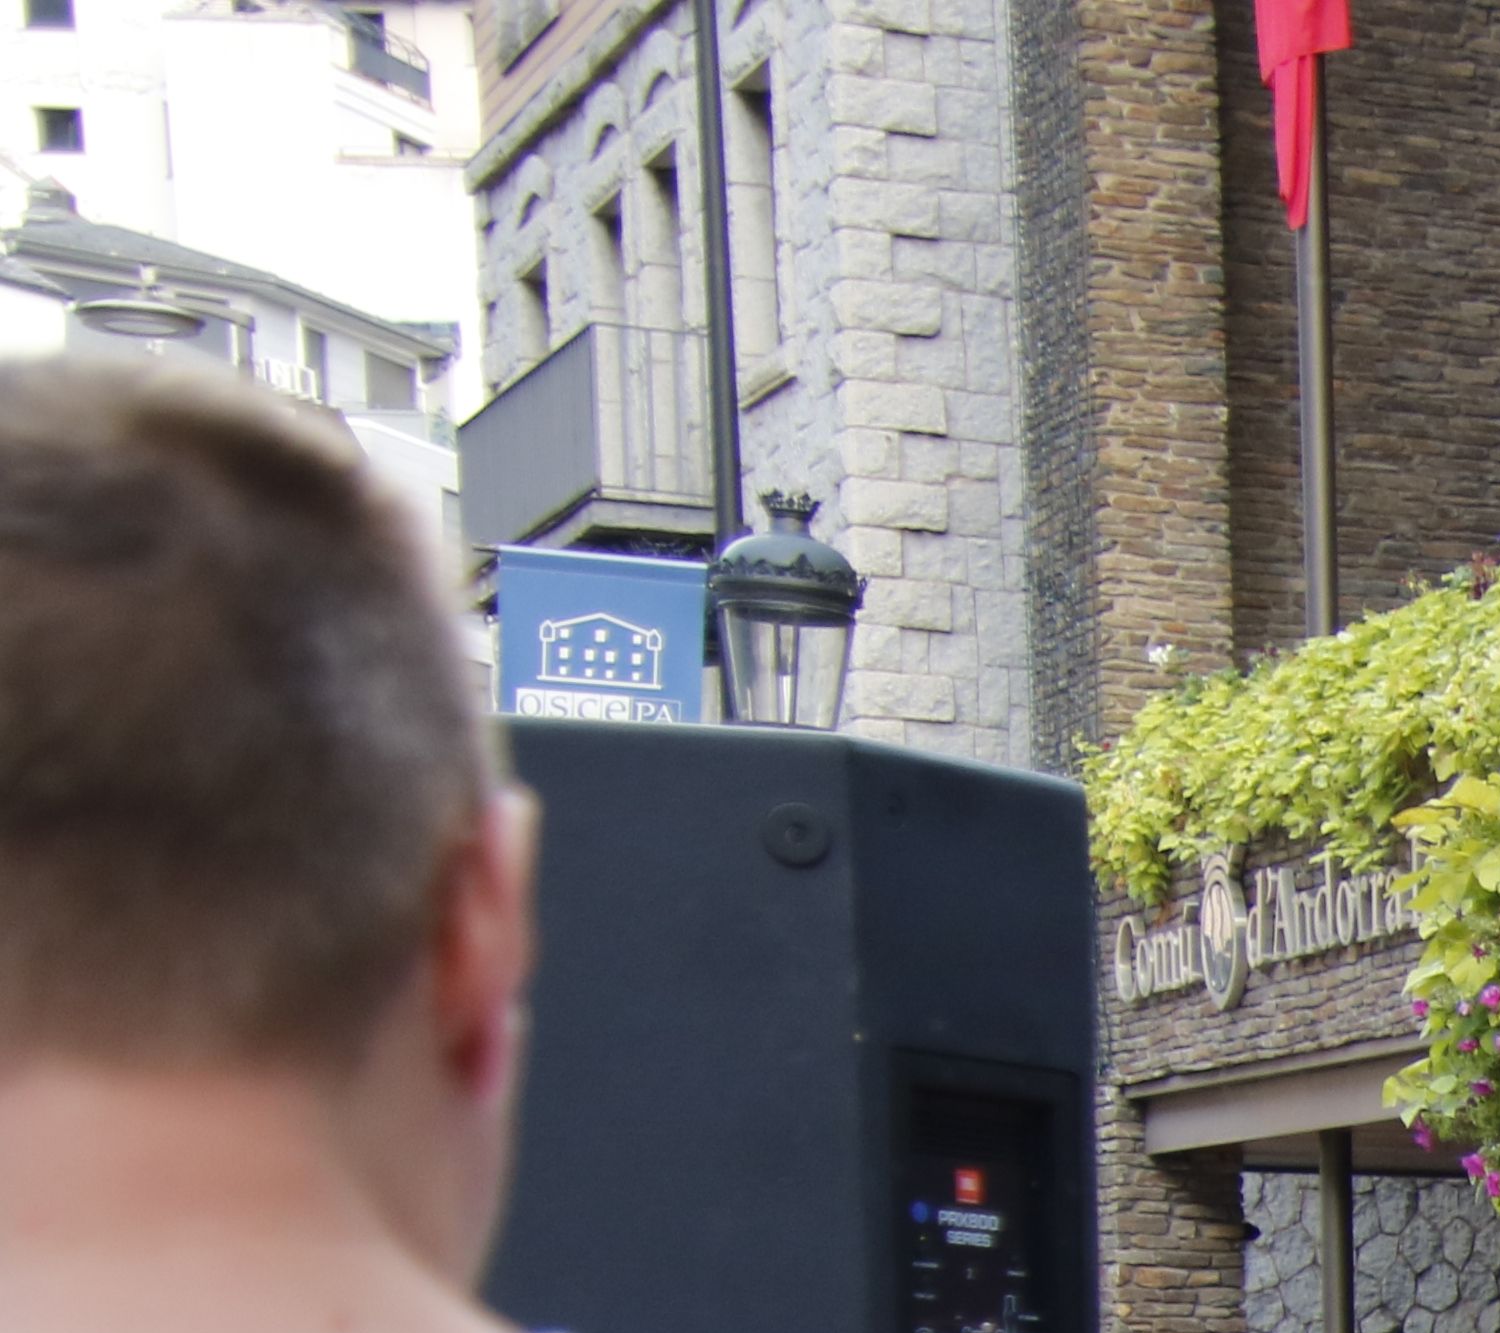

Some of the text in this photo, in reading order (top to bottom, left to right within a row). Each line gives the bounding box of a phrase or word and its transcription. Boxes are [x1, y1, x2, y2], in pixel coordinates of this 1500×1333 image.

[1115, 900, 1203, 1003] Comú
[1246, 850, 1410, 970] d'Andorra
[937, 1208, 1000, 1231] PRX800
[945, 1229, 992, 1248] SERIES
